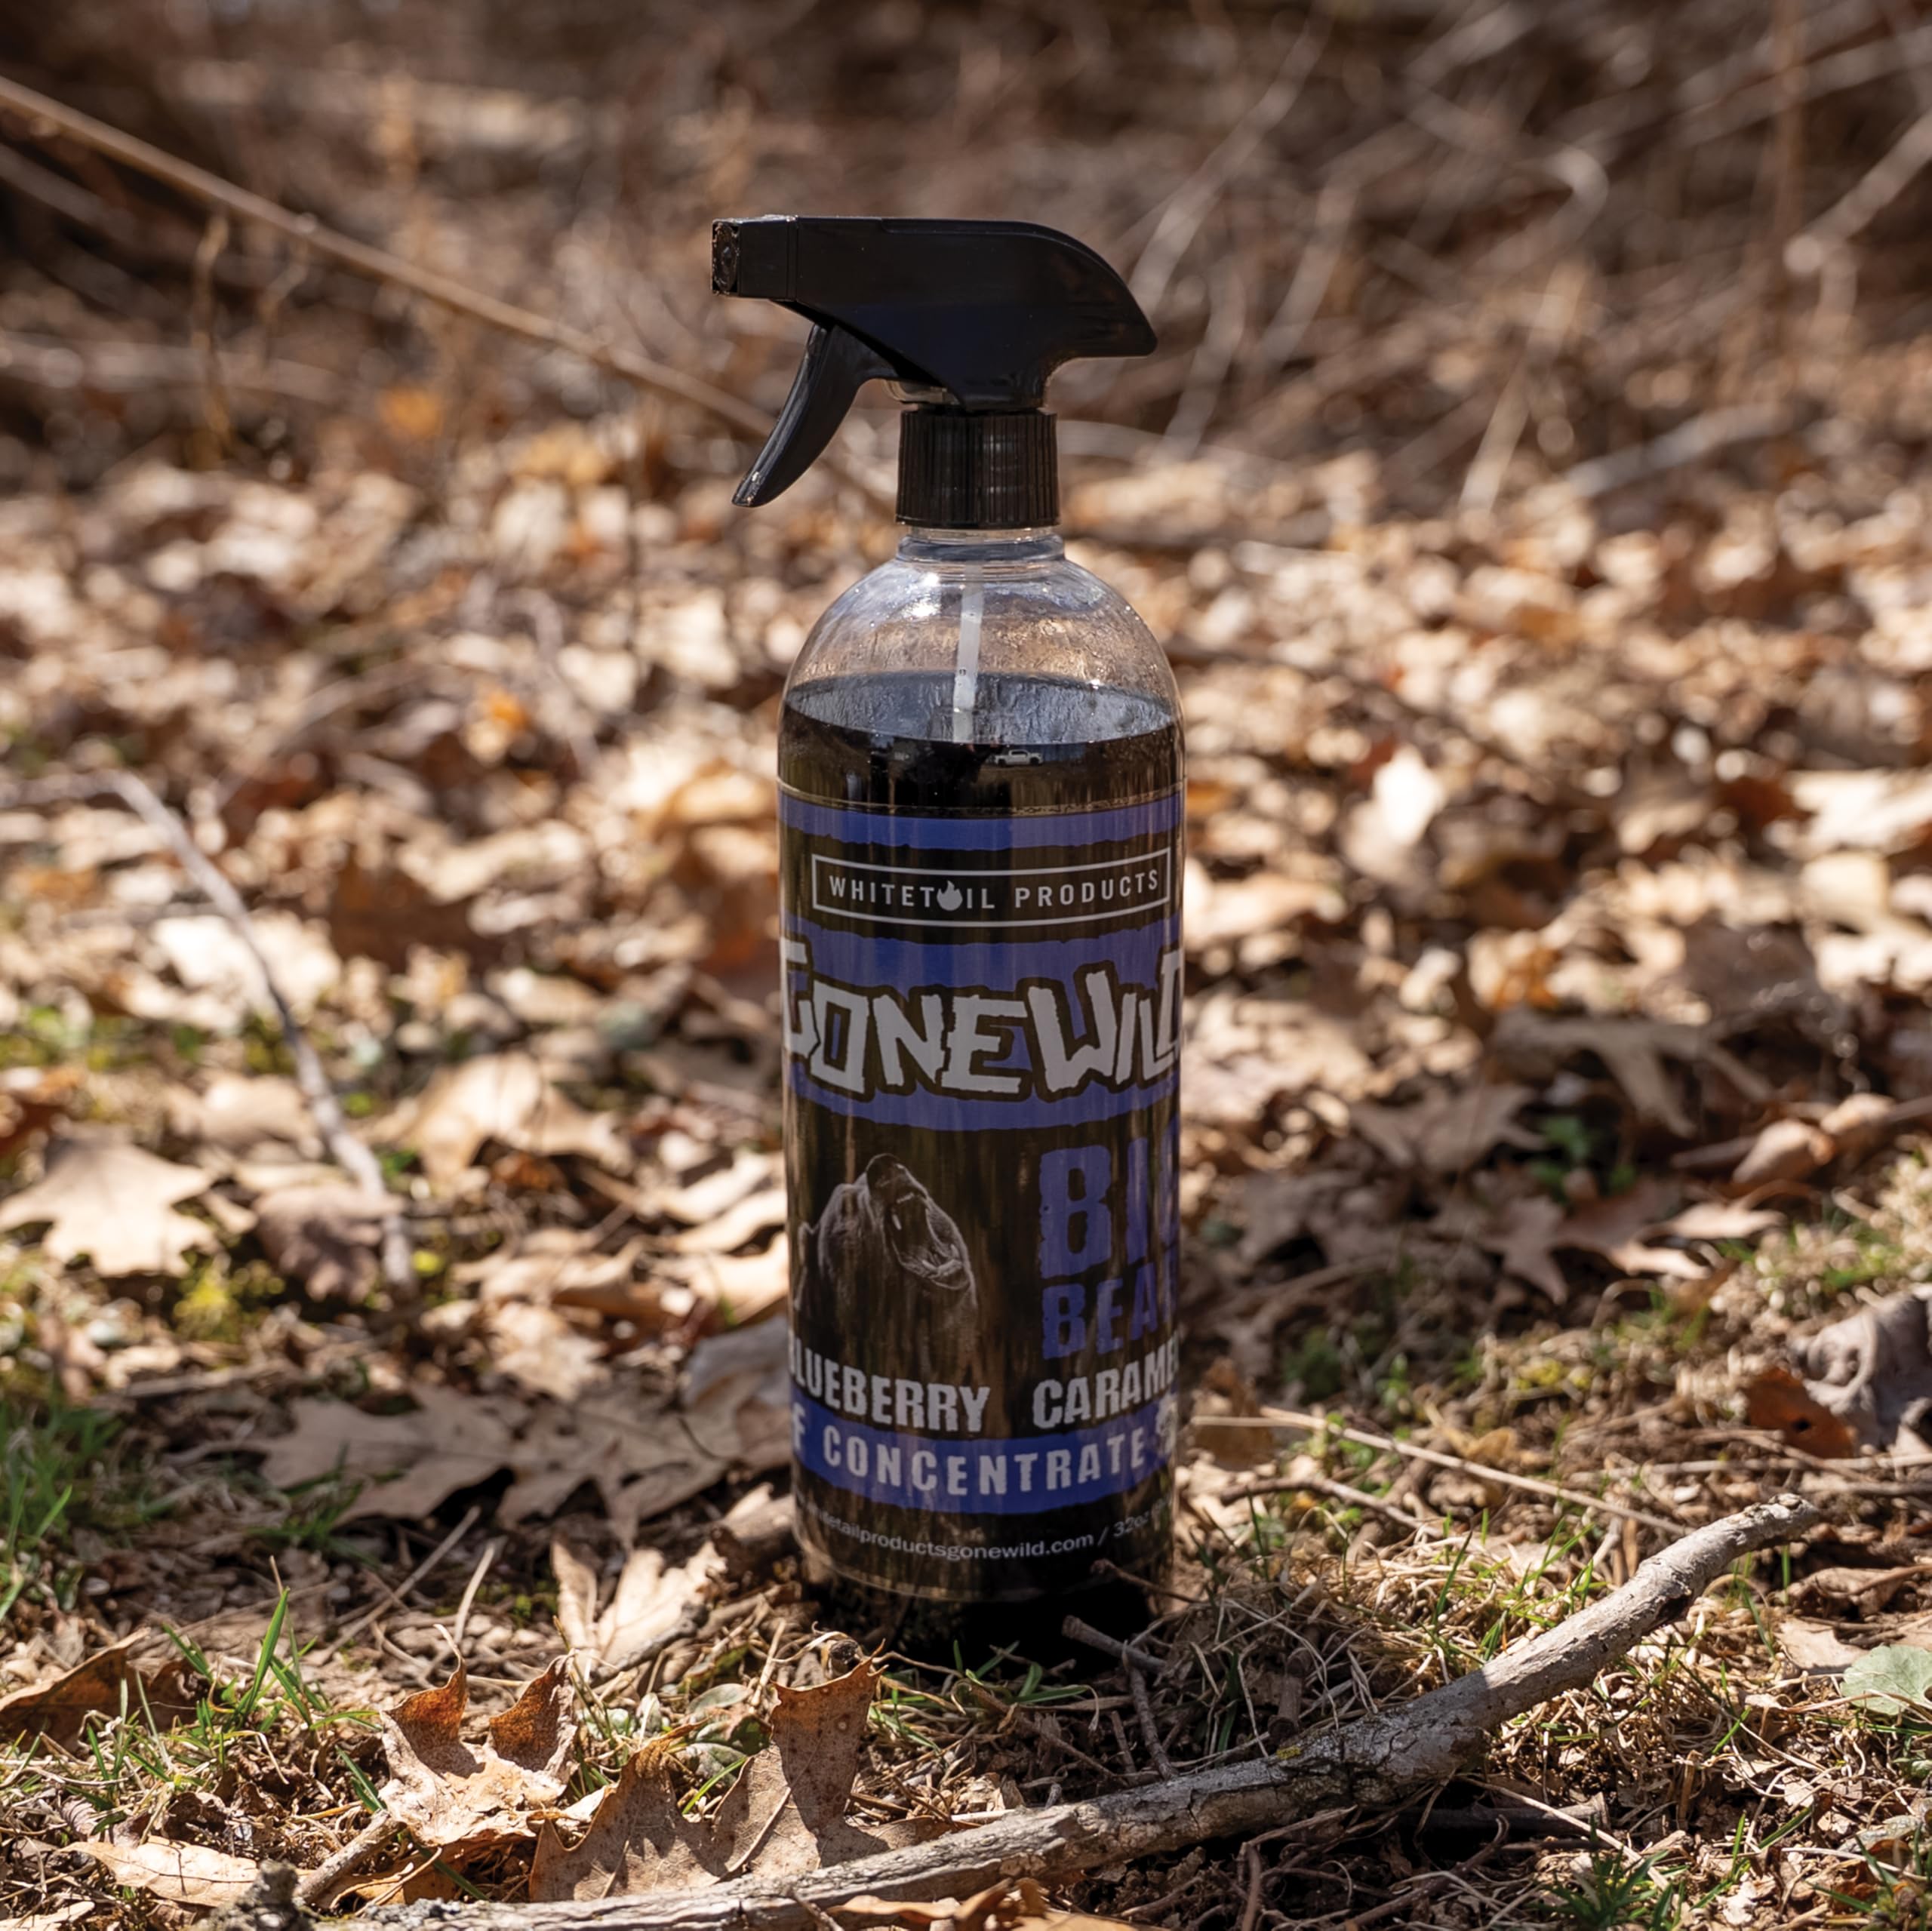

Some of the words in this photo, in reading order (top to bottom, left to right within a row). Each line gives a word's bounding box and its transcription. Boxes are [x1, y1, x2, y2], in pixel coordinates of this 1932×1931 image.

[829, 875, 995, 911] WHITETIL
[1015, 869, 1158, 908] PRODUCTS
[823, 1423, 1145, 1496] CONCENTRATE
